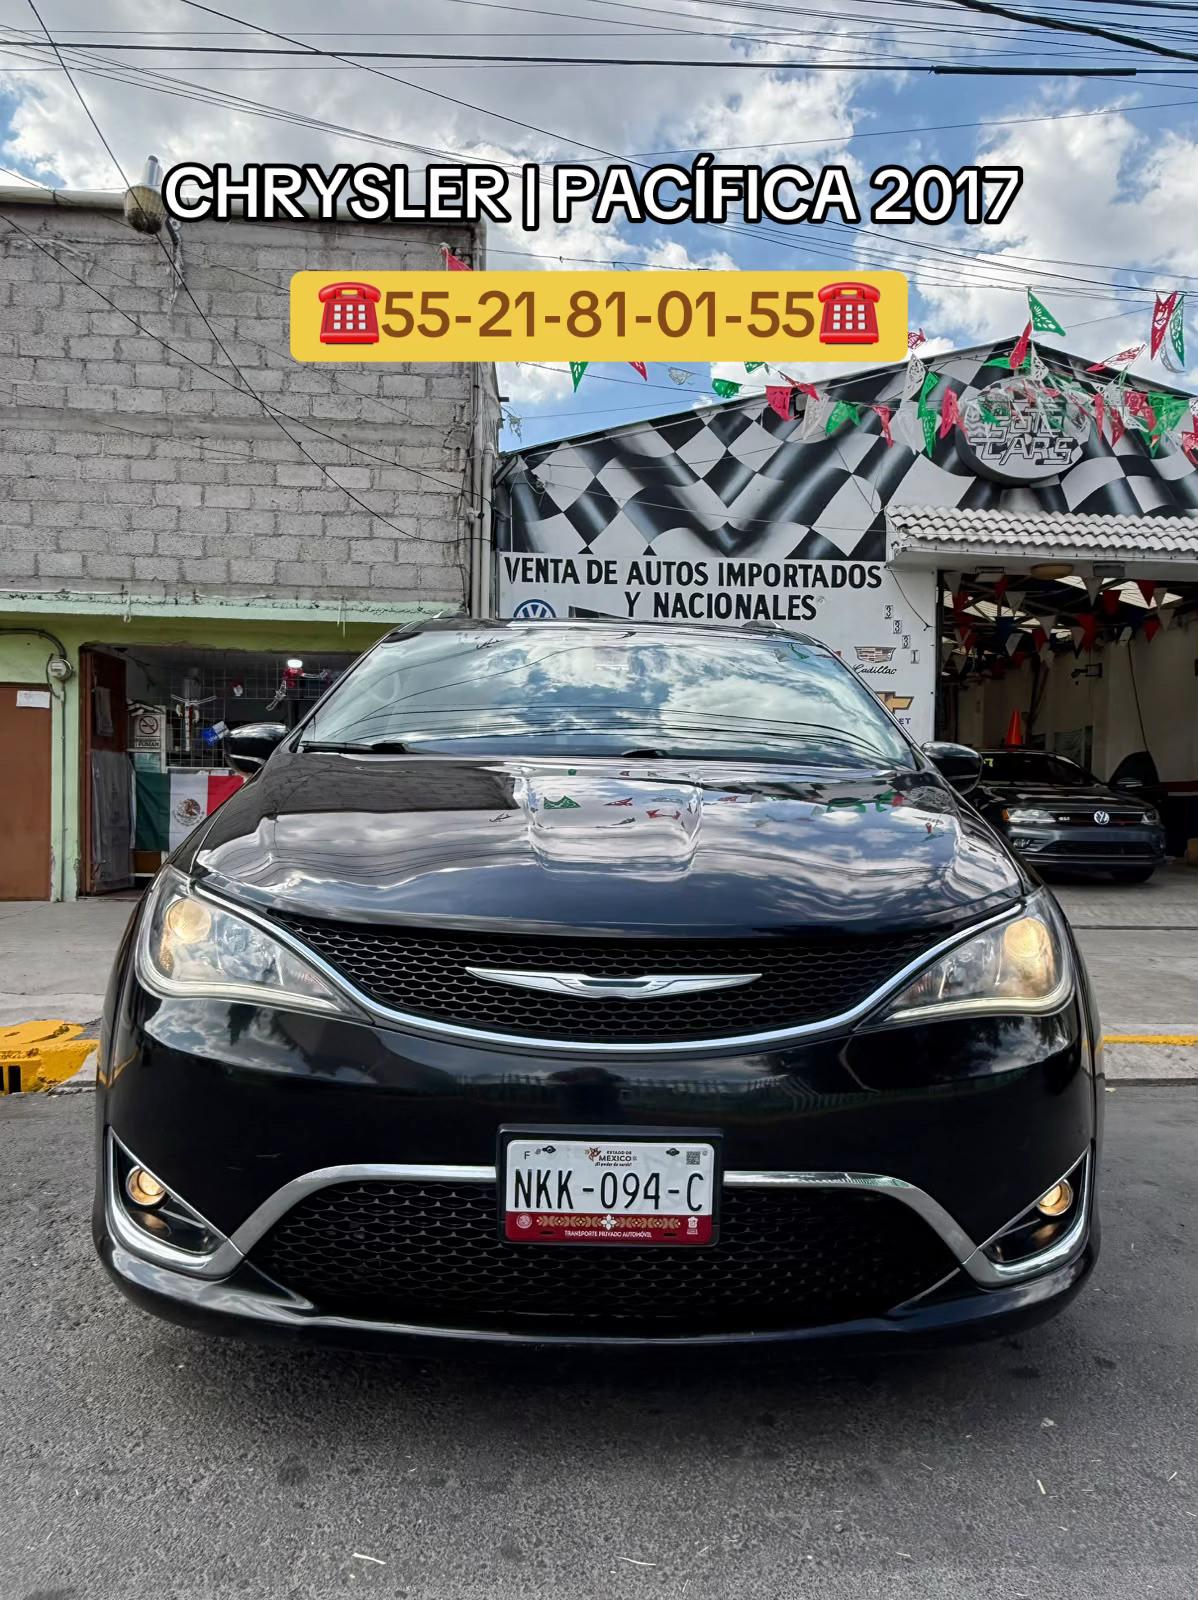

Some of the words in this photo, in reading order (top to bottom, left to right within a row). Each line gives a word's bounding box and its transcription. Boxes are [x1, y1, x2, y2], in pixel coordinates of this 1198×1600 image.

[503, 557, 580, 584] VENTA
[587, 560, 618, 584] DE
[626, 561, 709, 586] AUTOS
[718, 562, 882, 588] IMPORTADOS
[624, 592, 641, 617] Y
[653, 592, 817, 620] NACIONALES
[853, 663, 897, 675] Cadillac
[514, 1168, 704, 1211] NKK-094-C
